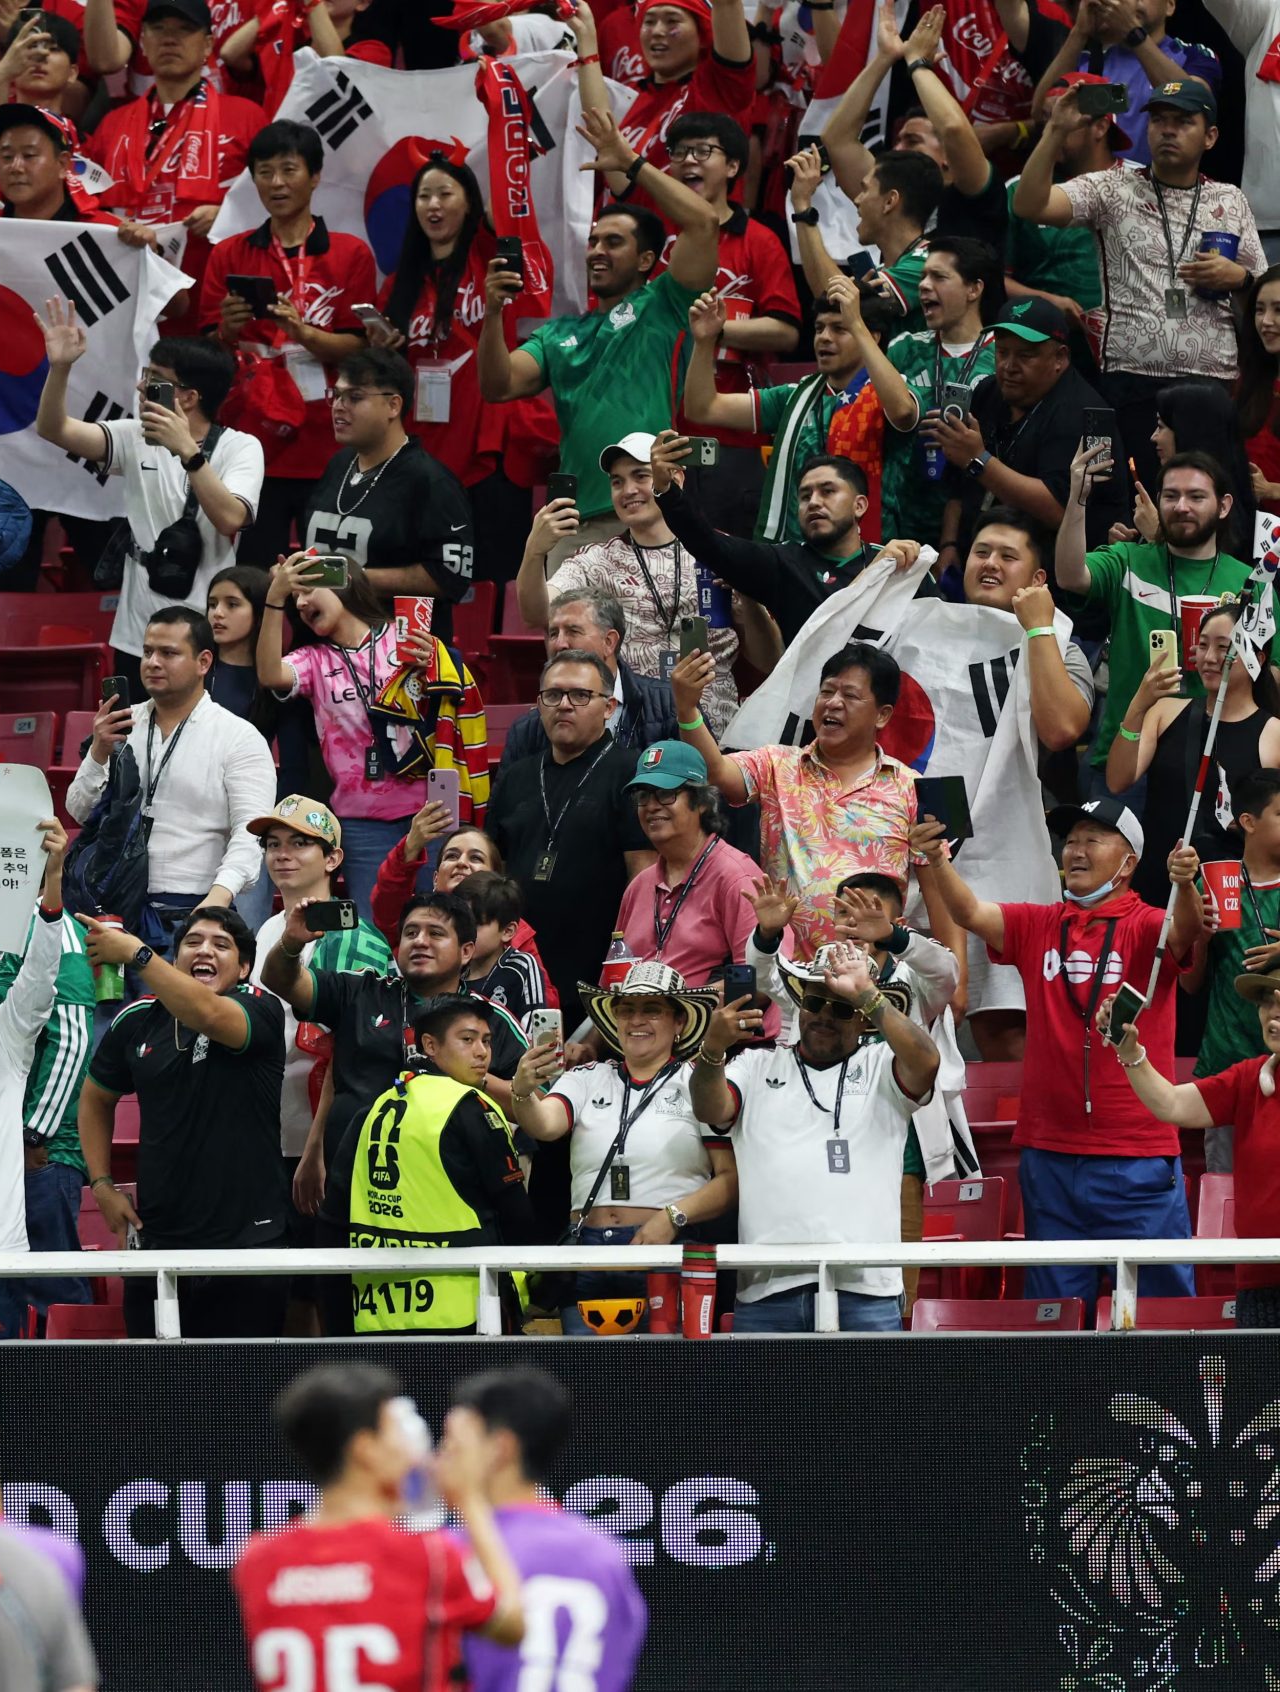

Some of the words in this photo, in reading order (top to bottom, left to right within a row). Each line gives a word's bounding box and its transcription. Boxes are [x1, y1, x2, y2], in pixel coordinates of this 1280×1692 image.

[442, 543, 473, 579] 52
[3, 862, 29, 875] 추억
[1222, 875, 1239, 889] KOR
[1224, 898, 1239, 911] CZE
[373, 1171, 392, 1183] FIFA
[387, 1193, 402, 1205] CUP
[368, 1200, 404, 1219] 2026
[1044, 1307, 1054, 1318] 2
